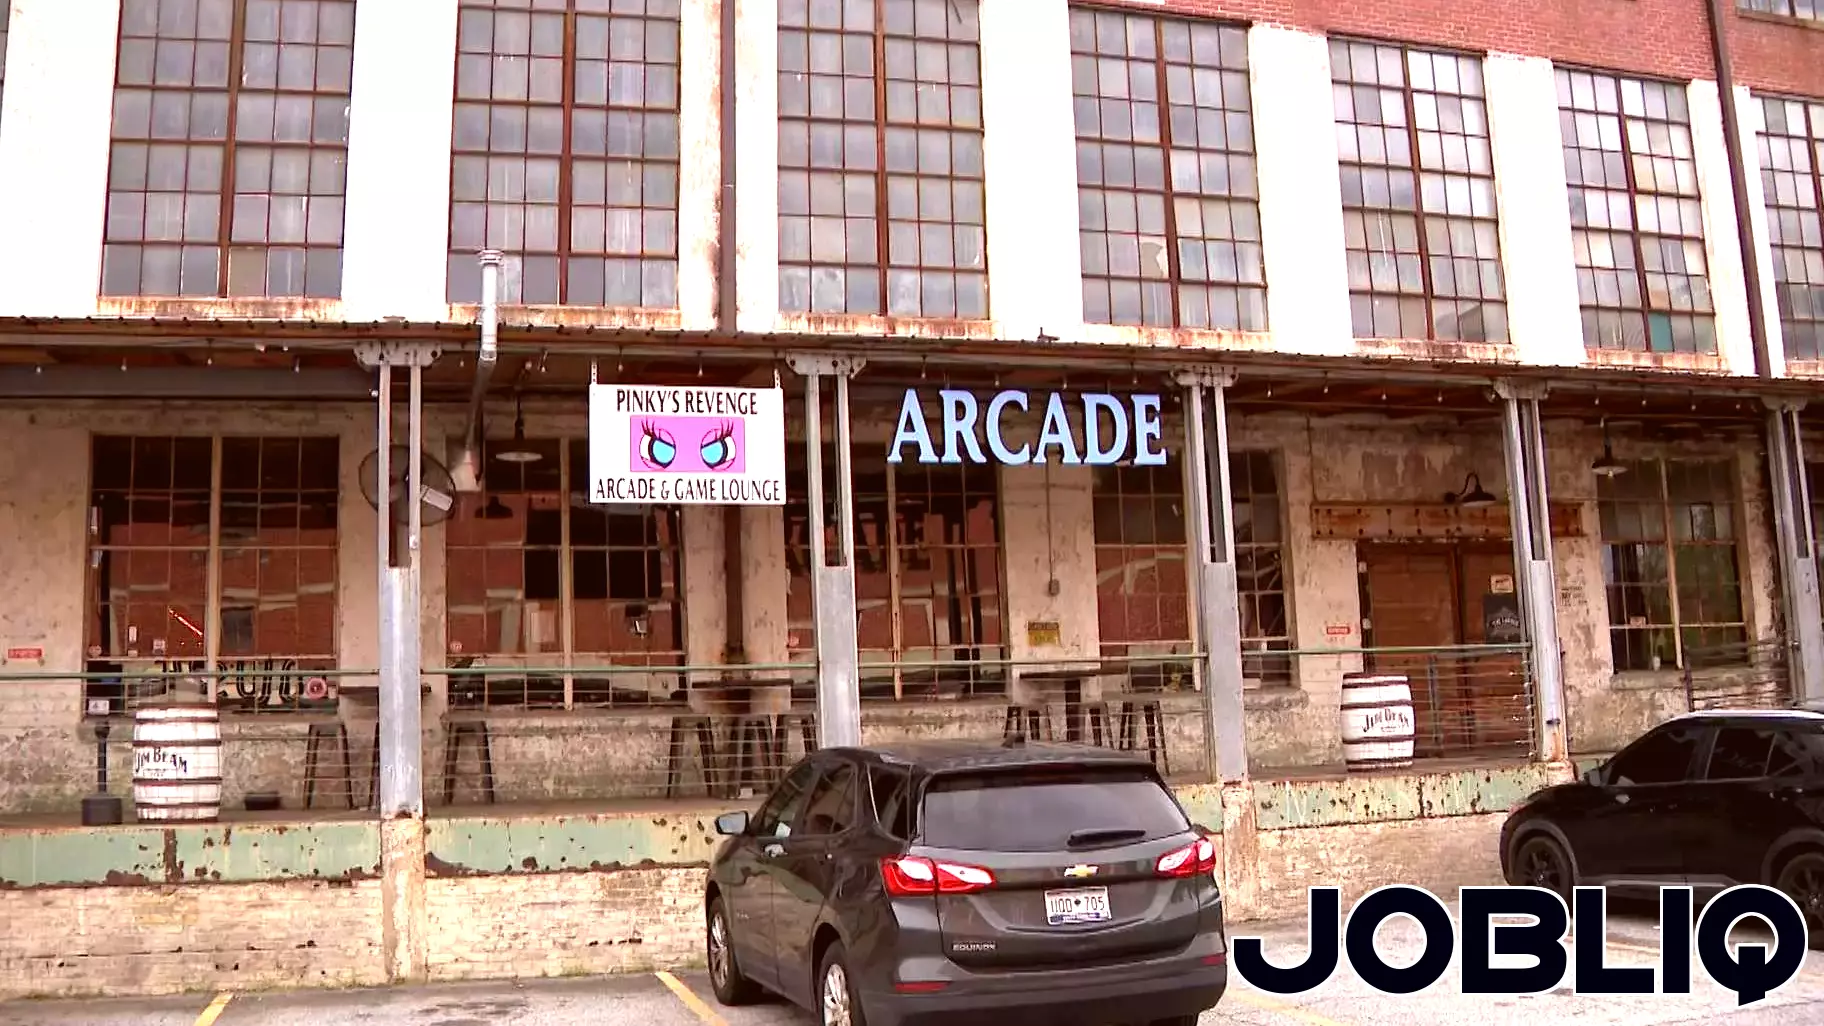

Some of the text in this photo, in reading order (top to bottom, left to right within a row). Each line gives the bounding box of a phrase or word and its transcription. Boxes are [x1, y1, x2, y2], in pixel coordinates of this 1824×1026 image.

[616, 388, 758, 415] PINKY'S REVENGE
[887, 388, 1167, 465] ARCADE
[596, 478, 780, 501] ARCADE & GAME LOUNGE
[1084, 896, 1105, 911] 705
